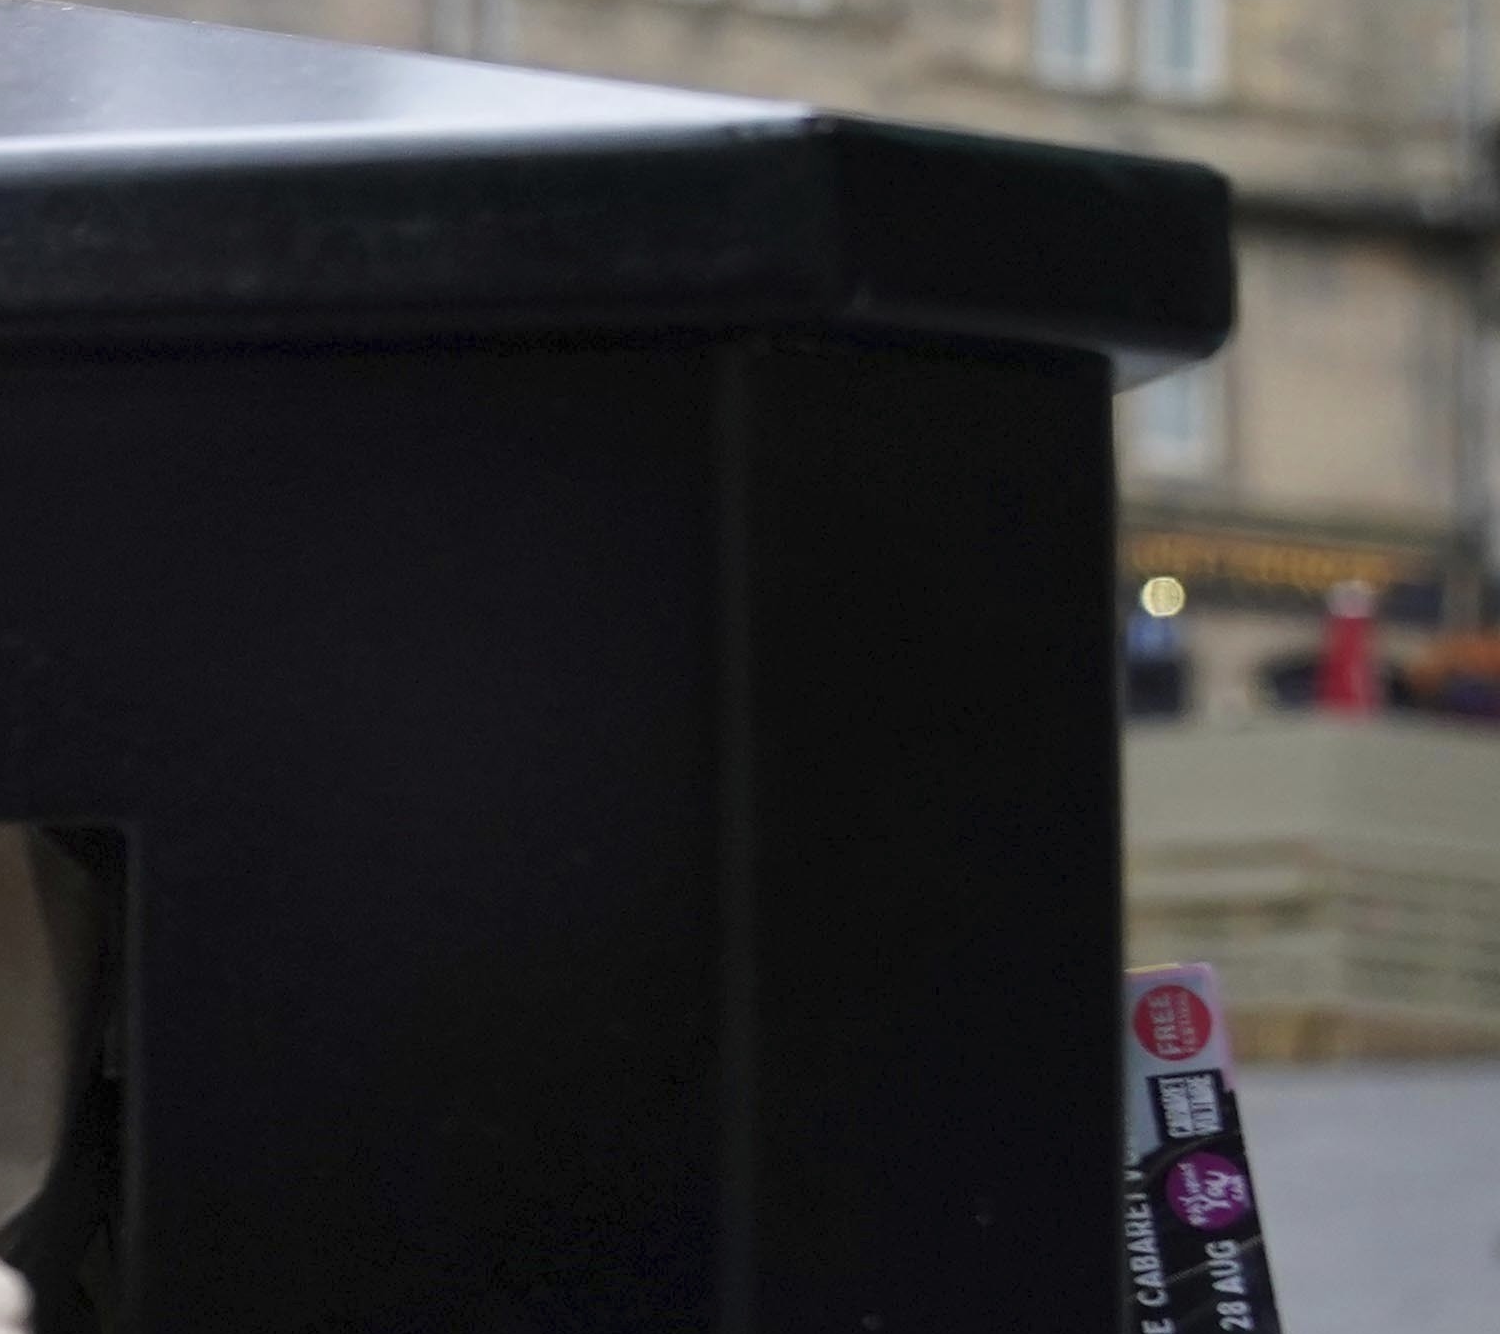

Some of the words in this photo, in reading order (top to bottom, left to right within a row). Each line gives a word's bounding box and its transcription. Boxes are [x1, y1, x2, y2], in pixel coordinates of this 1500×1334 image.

[1147, 991, 1182, 1056] FREE
[1203, 1239, 1248, 1295] AUG
[1216, 1301, 1254, 1330] 28
